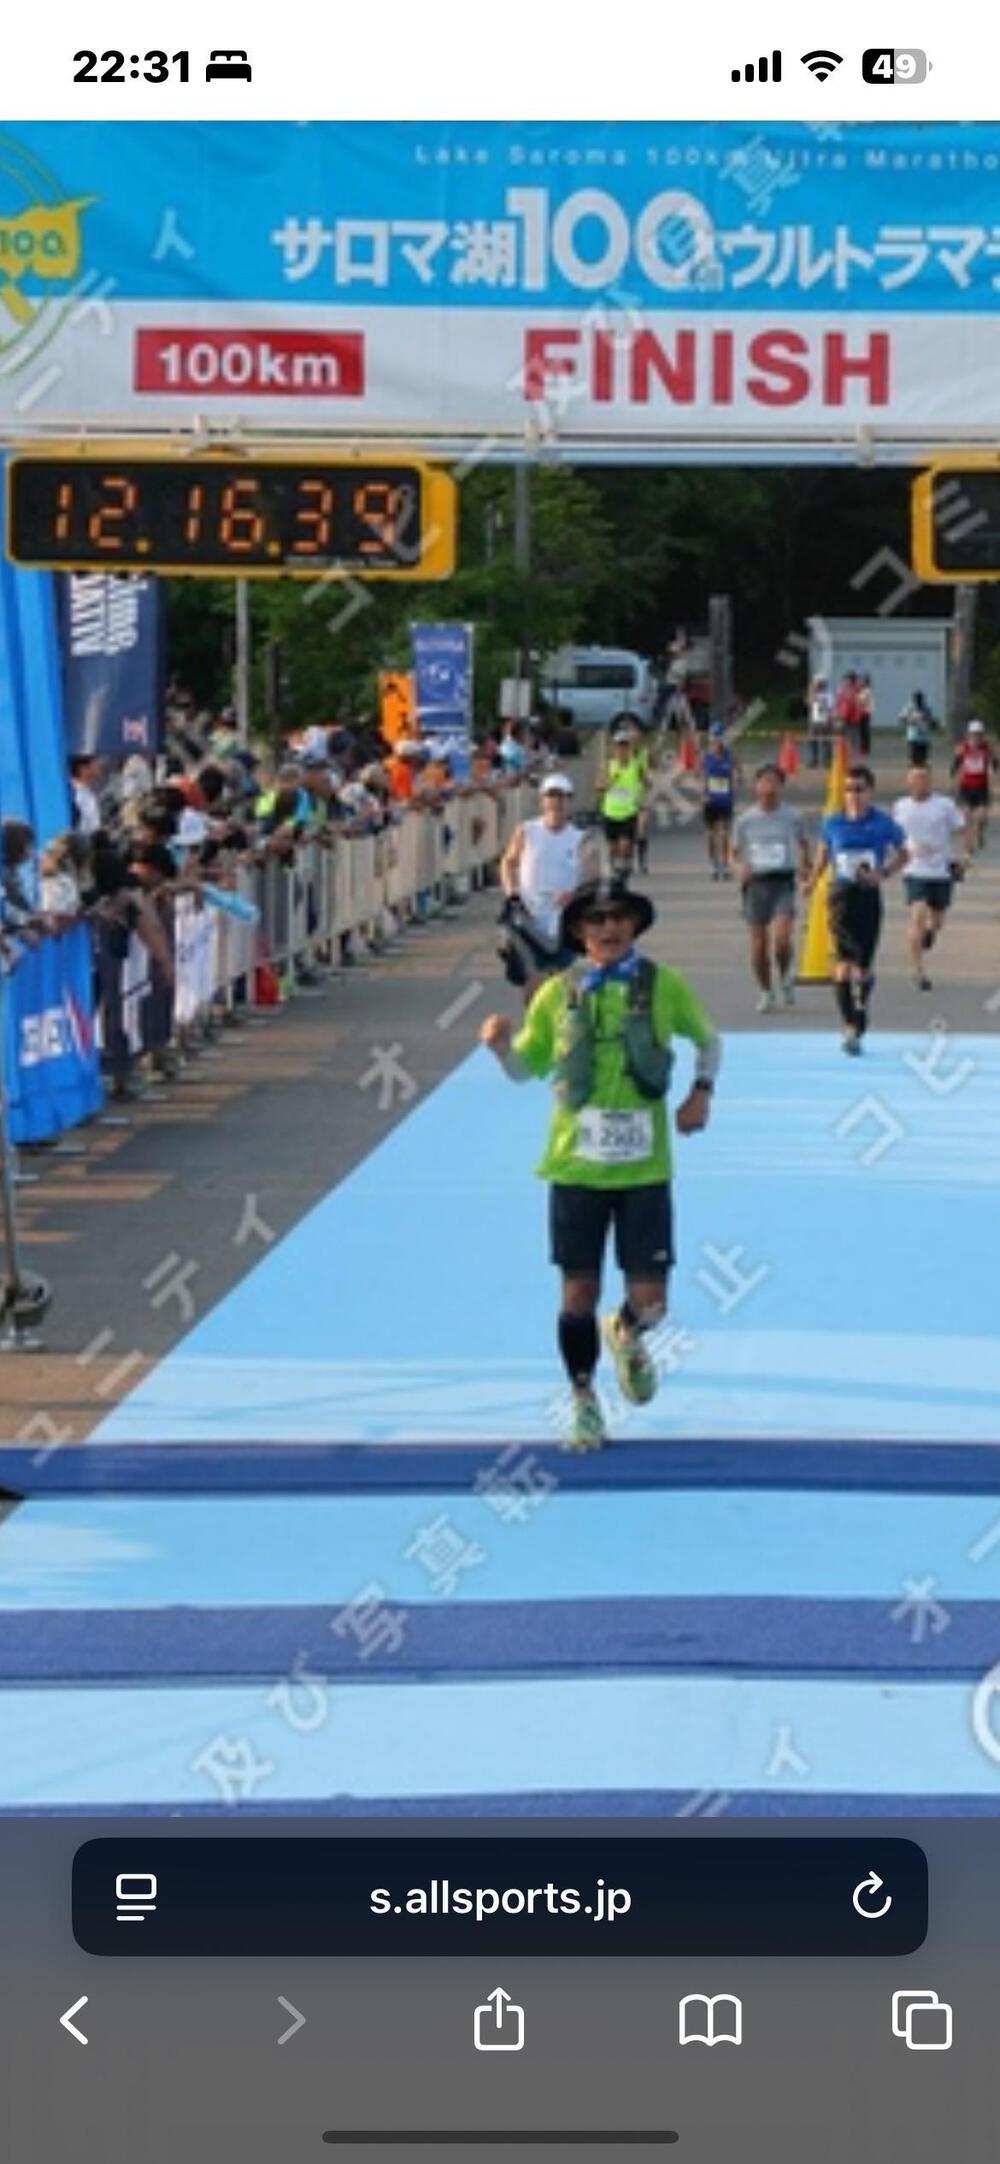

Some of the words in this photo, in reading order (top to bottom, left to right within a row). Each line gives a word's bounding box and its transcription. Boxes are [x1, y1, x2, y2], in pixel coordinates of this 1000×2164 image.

[73, 50, 189, 83] 22:31
[872, 54, 916, 79] 49
[415, 145, 489, 165] Lake
[510, 146, 627, 166] Saroma
[160, 344, 339, 386] 100km
[524, 328, 889, 408] FINISH
[55, 475, 396, 554] 12.16.39
[370, 1878, 632, 1922] s.allsports.jp
